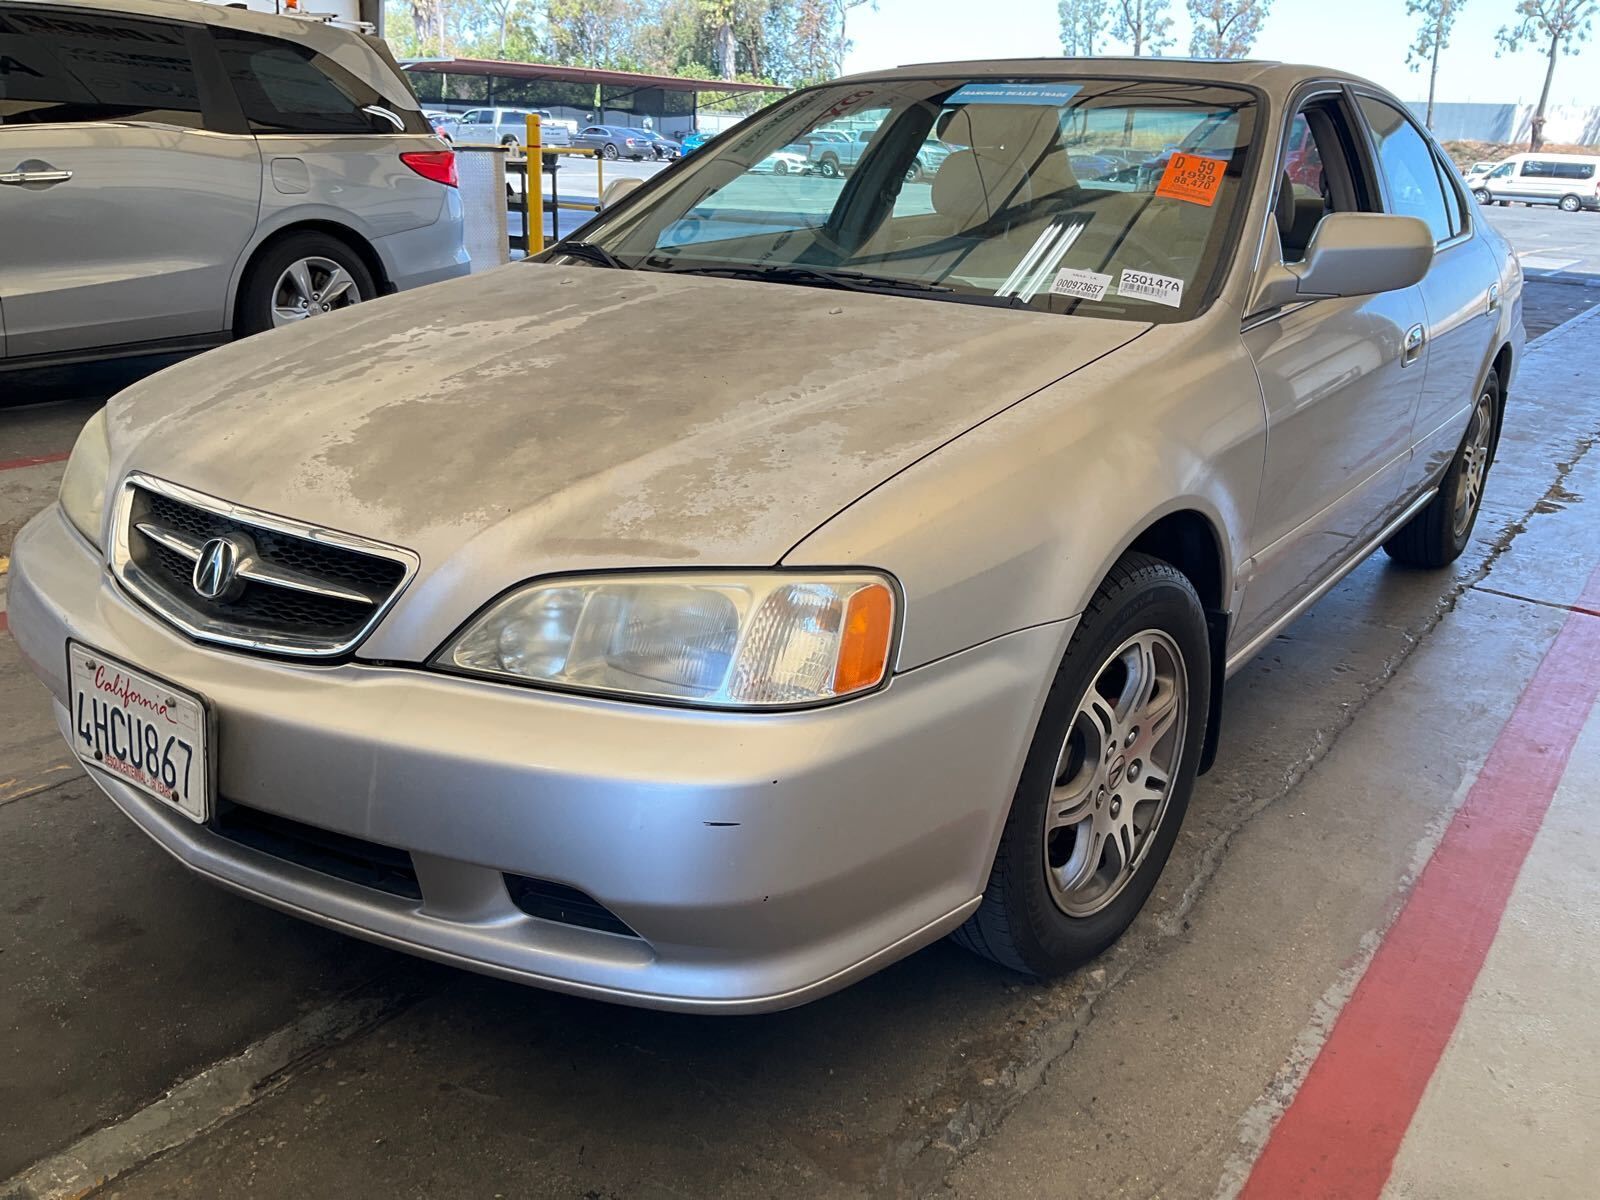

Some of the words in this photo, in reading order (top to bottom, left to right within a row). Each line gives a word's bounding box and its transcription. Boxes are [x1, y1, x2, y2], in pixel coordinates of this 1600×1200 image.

[1174, 156, 1185, 169] D
[1198, 160, 1216, 175] 59
[1181, 170, 1216, 183] 1999
[1056, 278, 1104, 294] 000973657
[95, 665, 177, 724] California
[78, 691, 192, 799] 4HCU867
